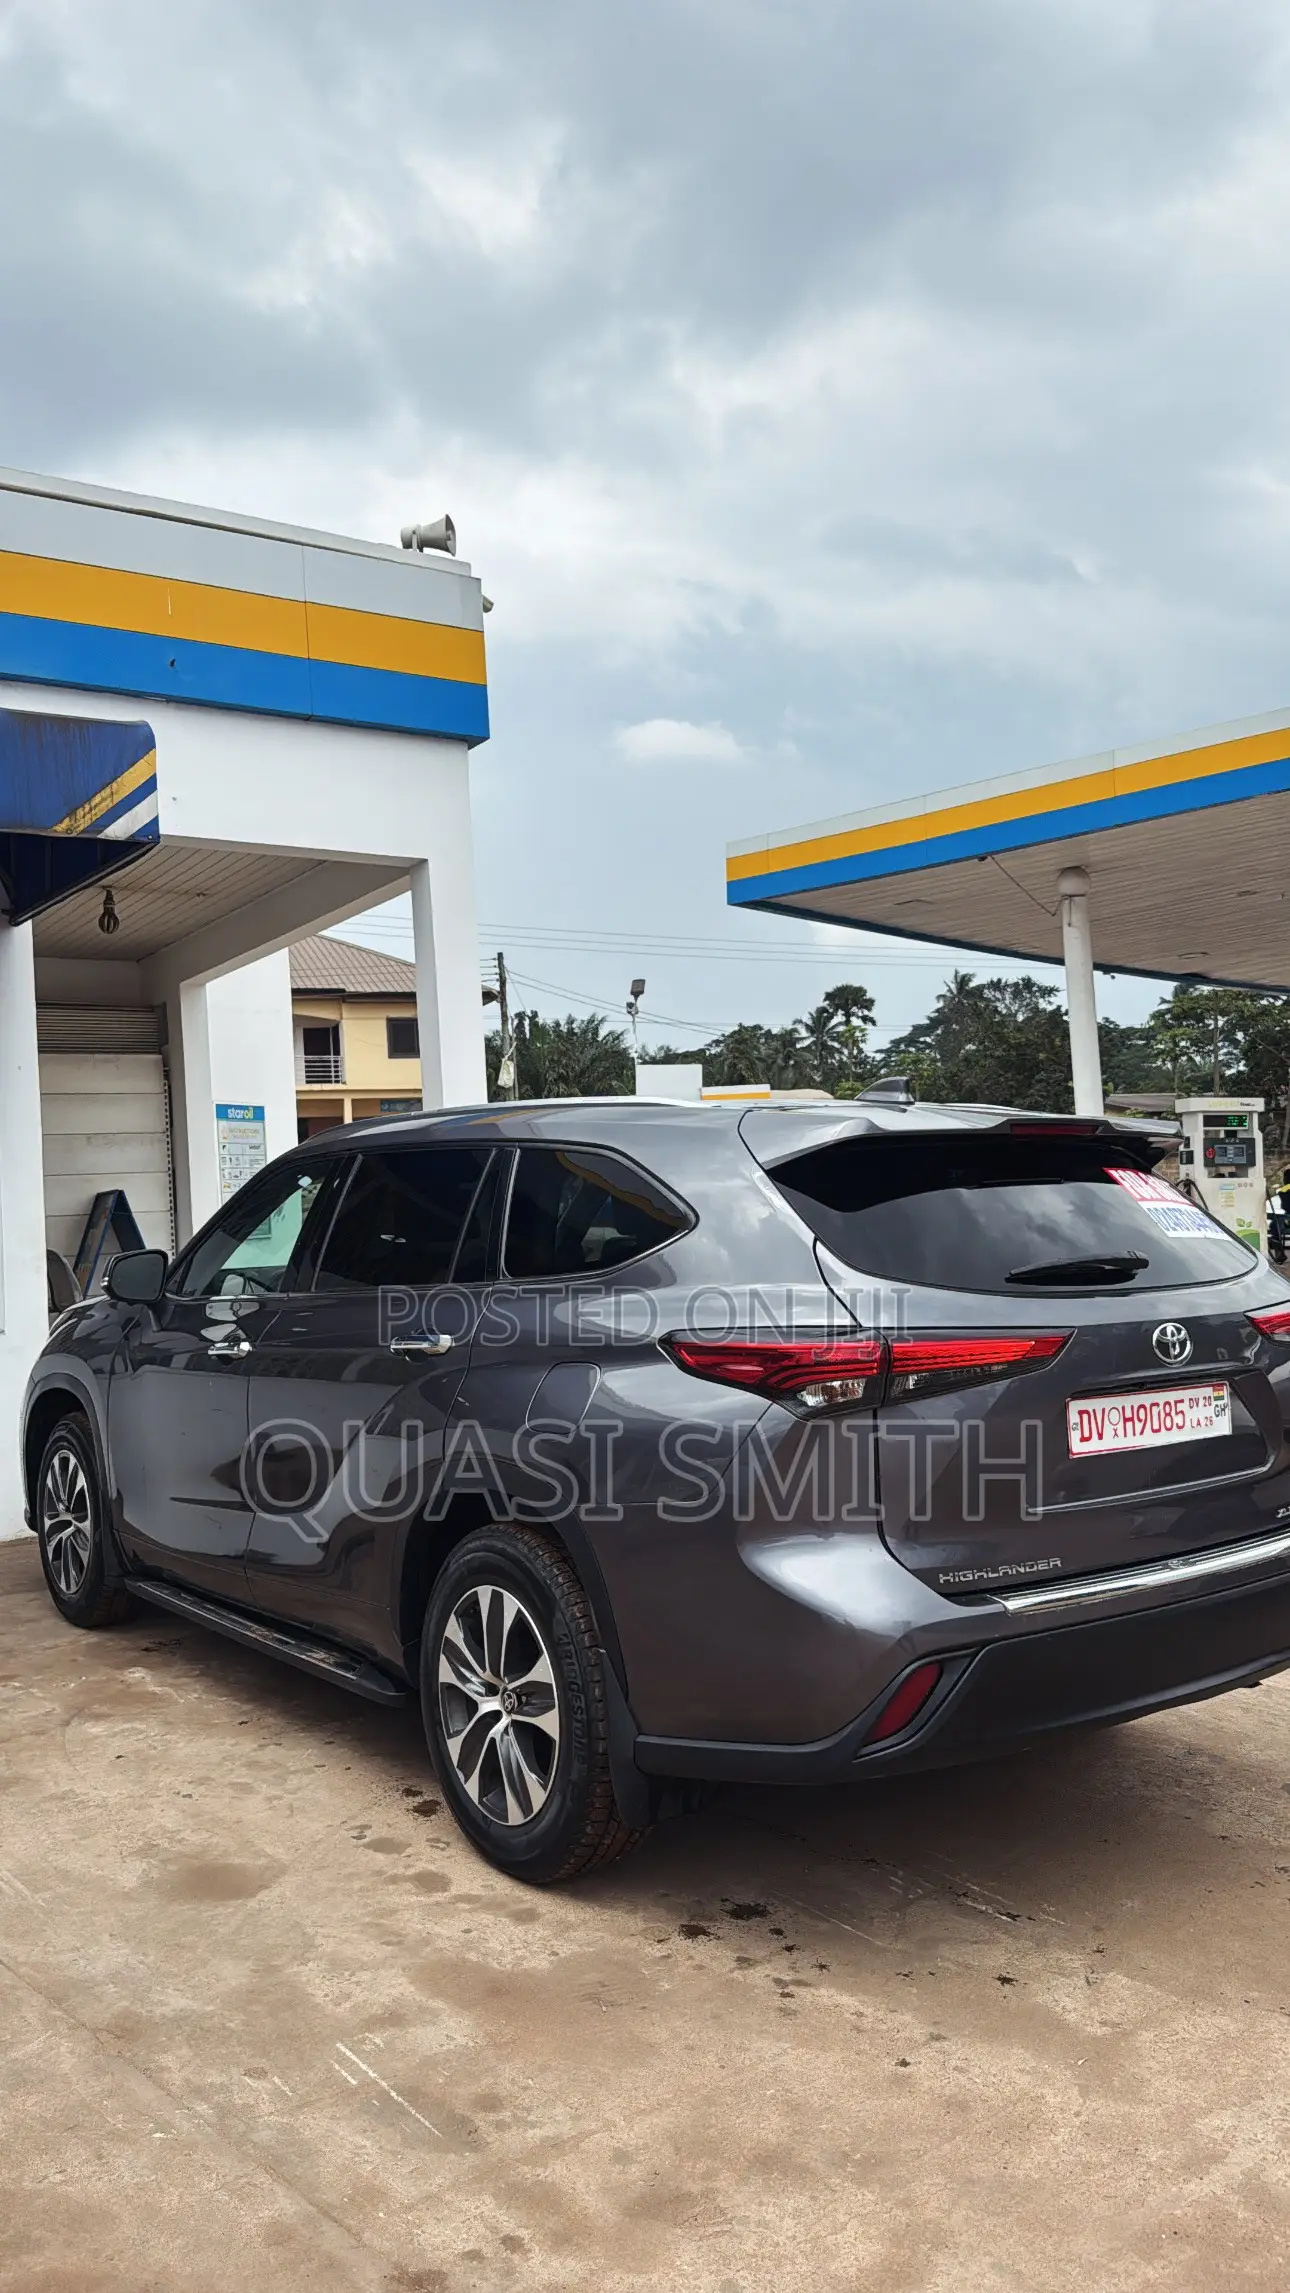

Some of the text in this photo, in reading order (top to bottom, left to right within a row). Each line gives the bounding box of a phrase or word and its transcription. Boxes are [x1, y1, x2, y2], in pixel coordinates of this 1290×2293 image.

[227, 1107, 254, 1119] staroil
[1188, 1396, 1212, 1409] DV 20
[1077, 1399, 1185, 1443] DV H9085
[1190, 1417, 1201, 1428] LA
[939, 1557, 1062, 1584] HIGHLANDER
